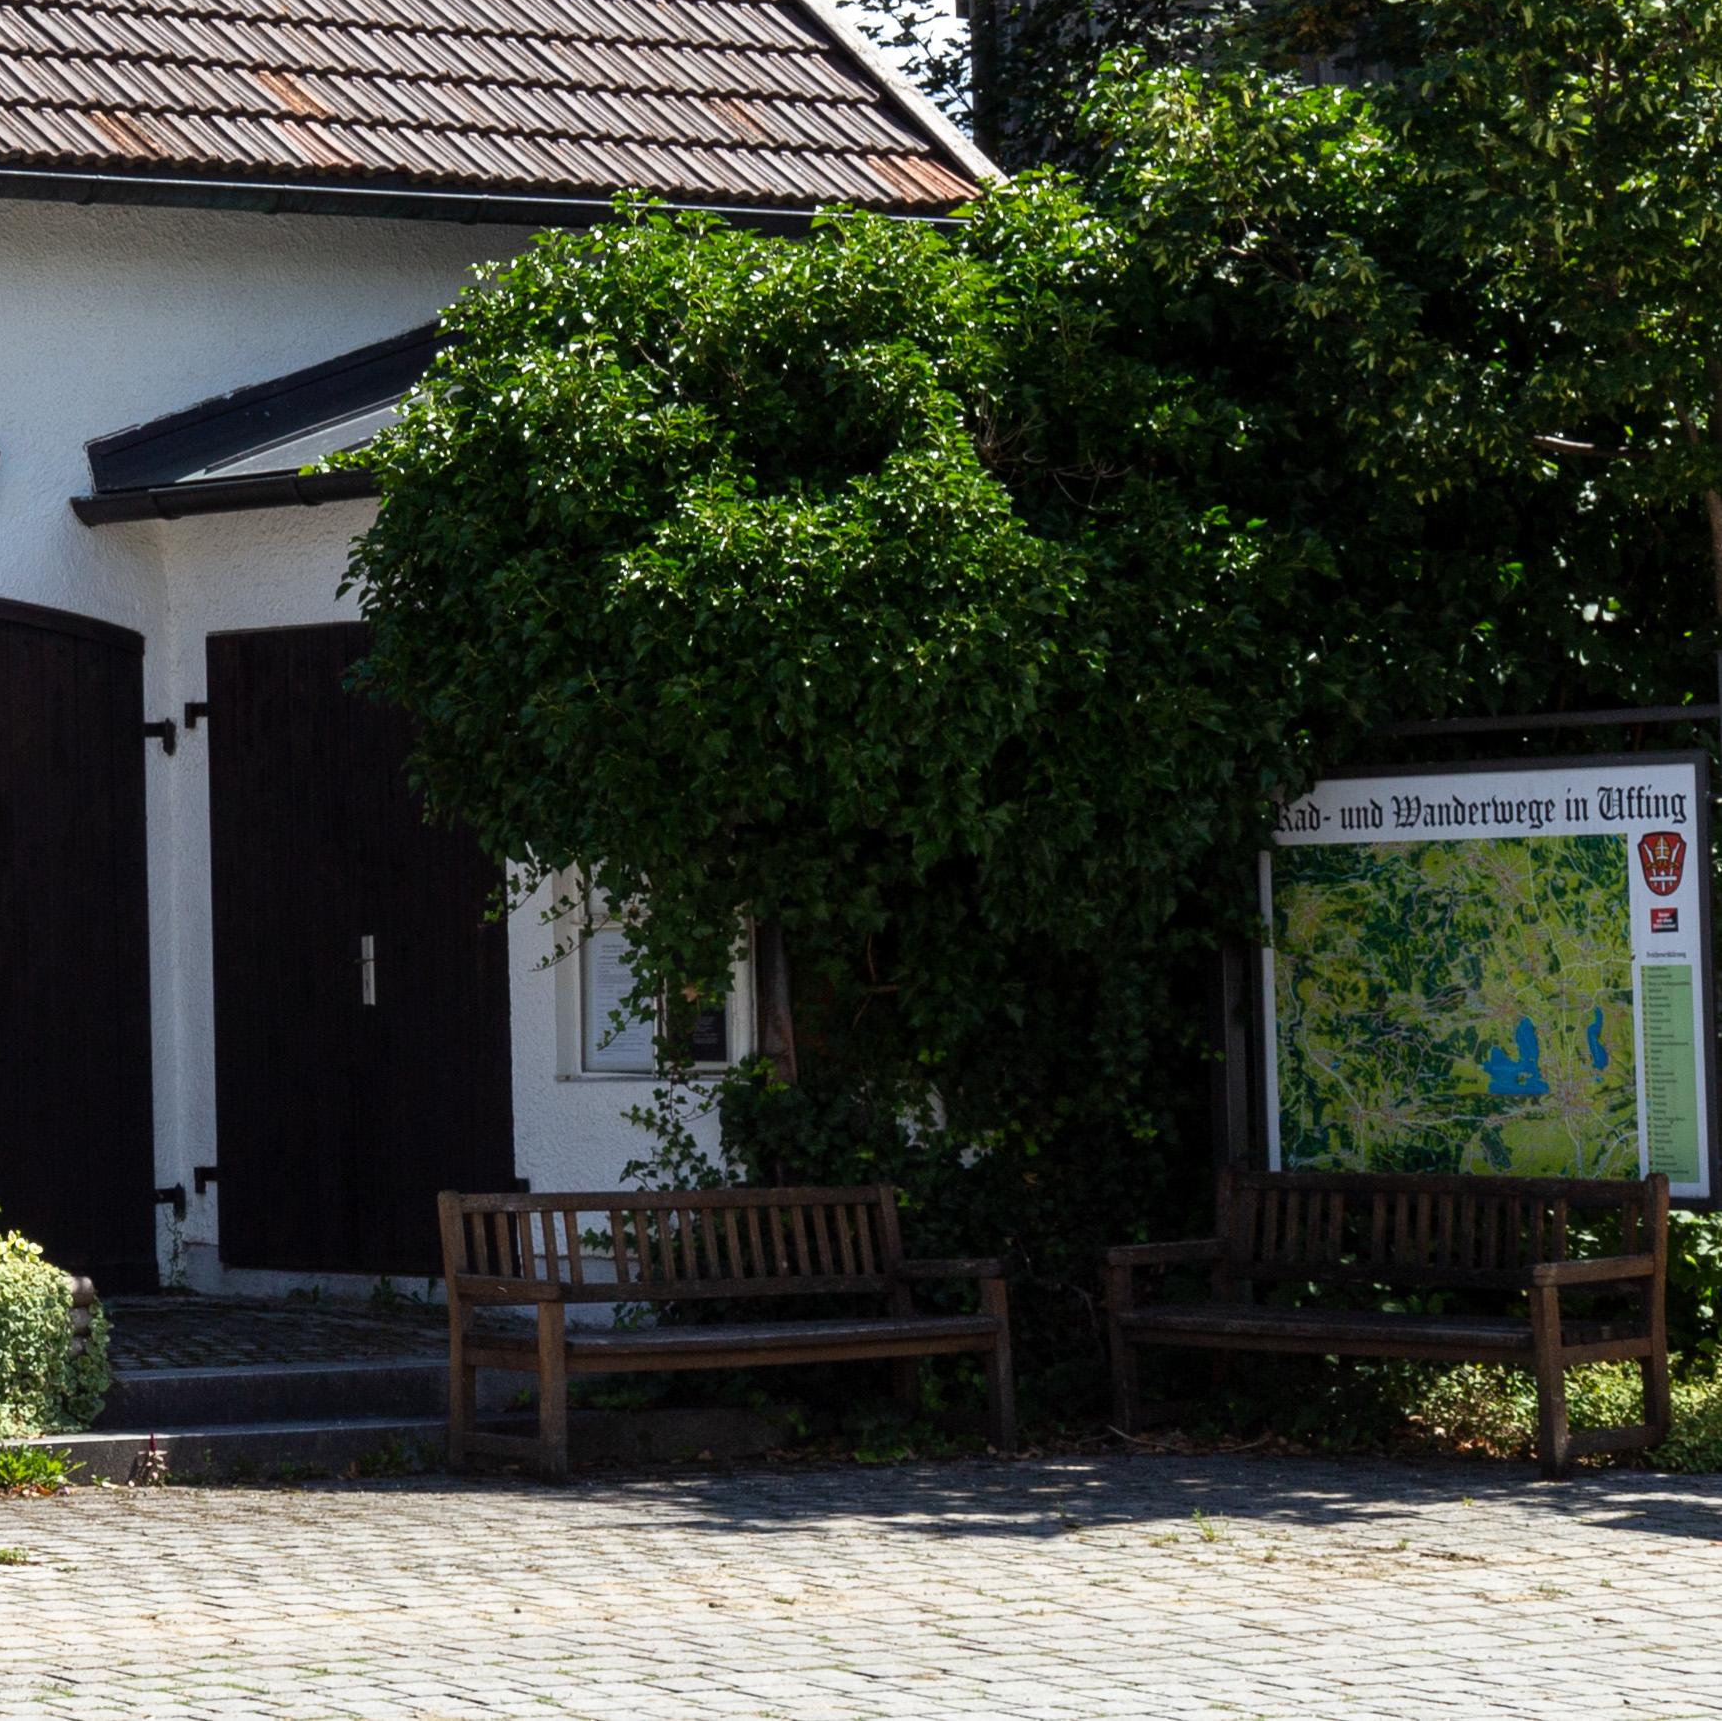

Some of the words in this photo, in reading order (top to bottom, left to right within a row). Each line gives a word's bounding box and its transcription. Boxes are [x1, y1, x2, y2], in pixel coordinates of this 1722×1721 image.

[1272, 799, 1331, 832] Rad-
[1339, 797, 1384, 830] und
[1390, 793, 1556, 830] Wanderwege
[1565, 787, 1590, 822] in
[1597, 784, 1687, 825] Uffing
